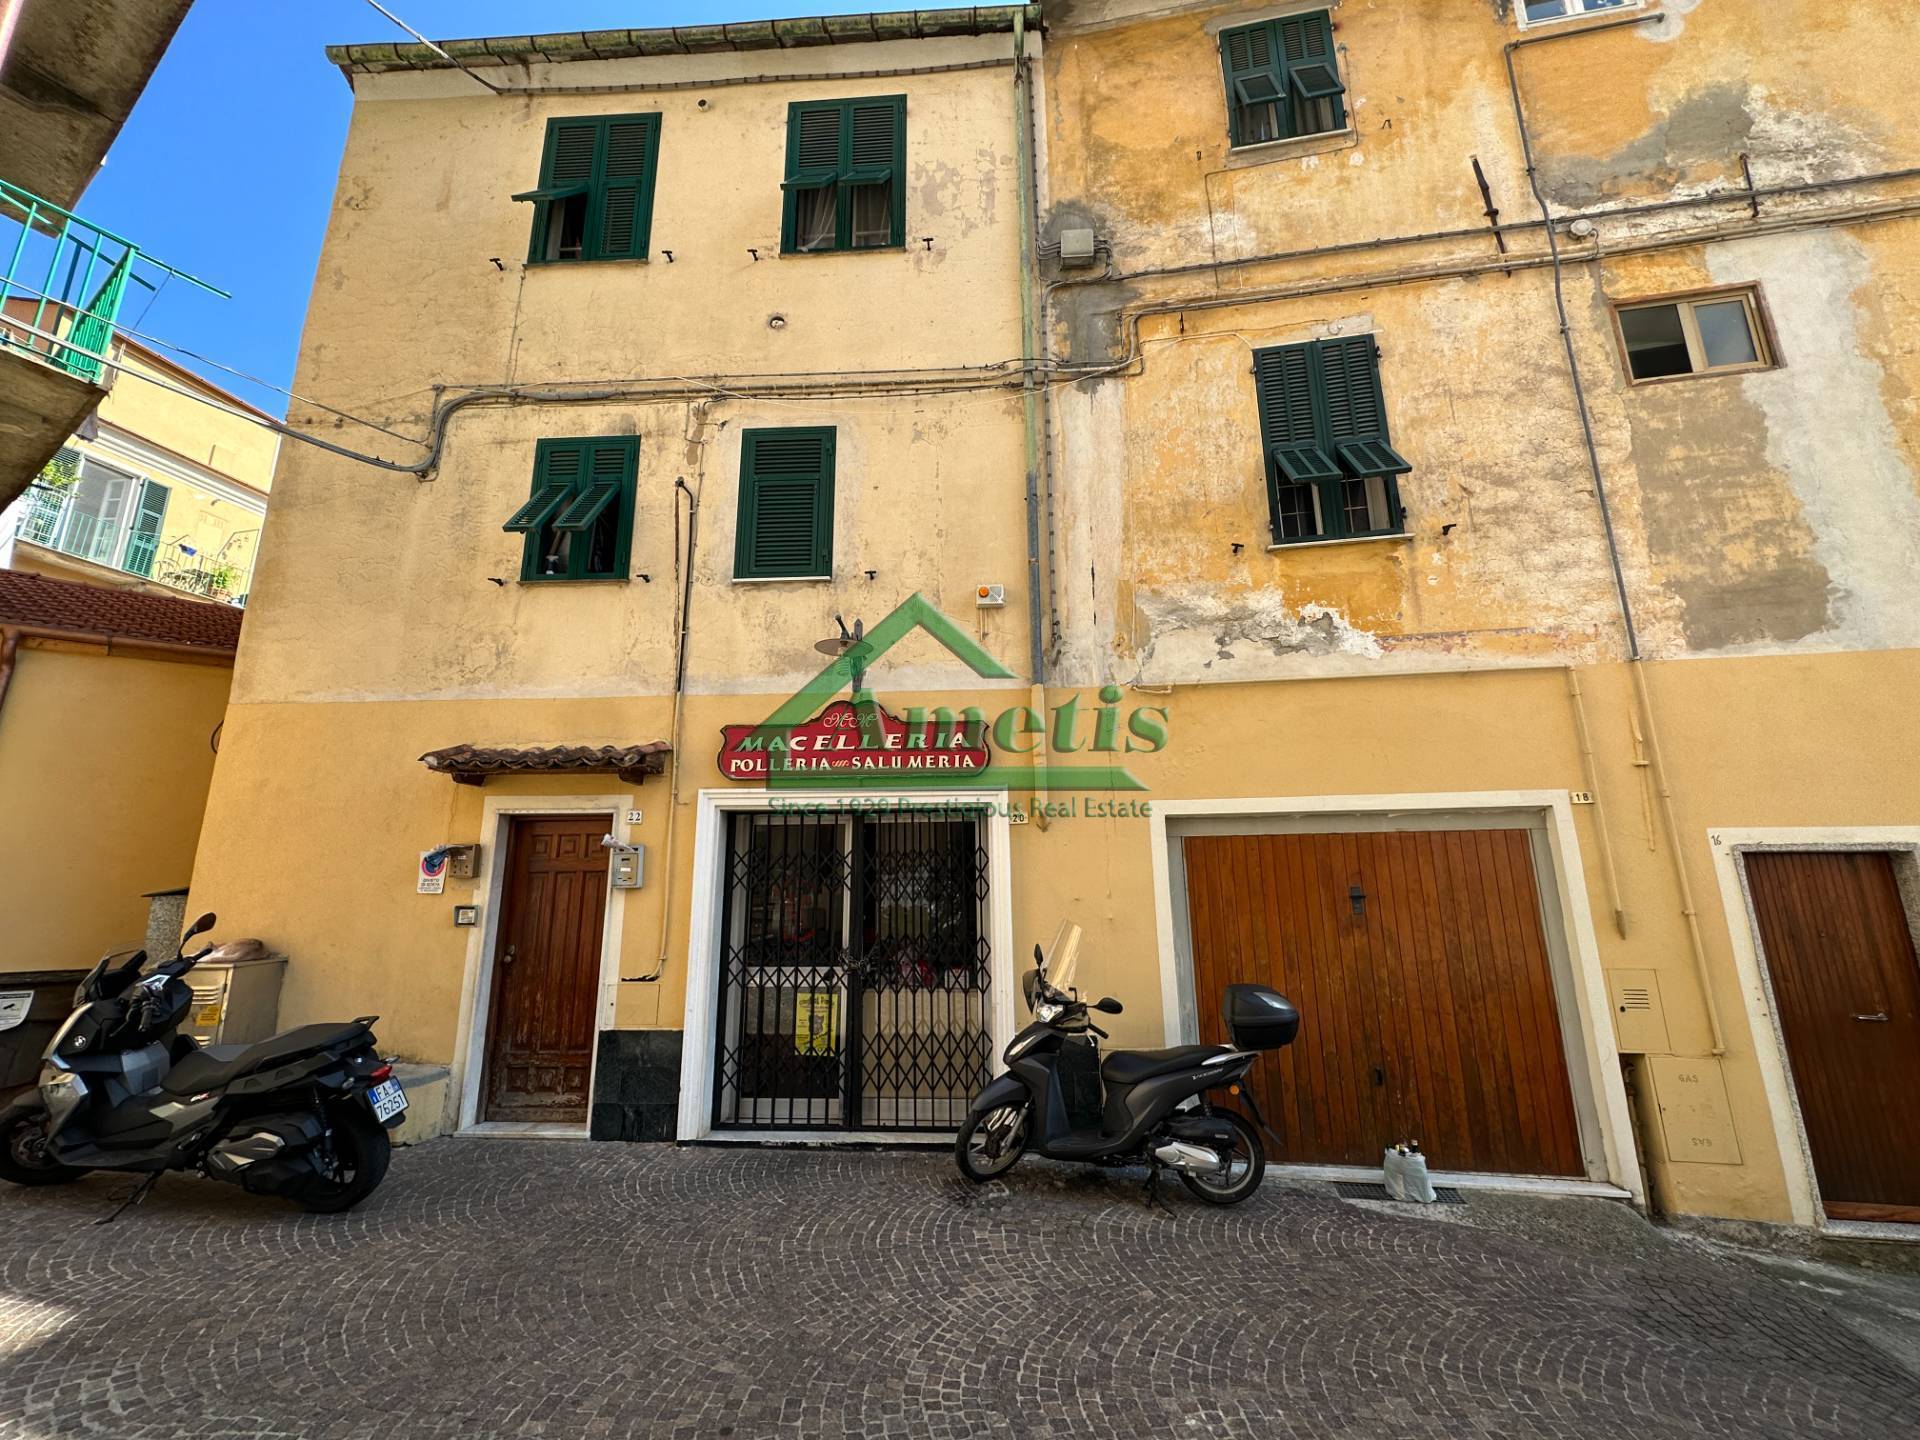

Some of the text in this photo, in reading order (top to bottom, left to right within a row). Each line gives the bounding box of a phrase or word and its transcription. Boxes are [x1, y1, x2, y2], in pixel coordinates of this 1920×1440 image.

[735, 732, 972, 752] MACELLERIA
[730, 754, 976, 772] POLLERIA SALUMERIA
[1575, 792, 1590, 802] 18
[628, 811, 641, 822] 22
[1012, 814, 1025, 823] 20
[1678, 1073, 1698, 1084] GAS
[375, 1084, 391, 1100] FA
[376, 1093, 406, 1119] 76251
